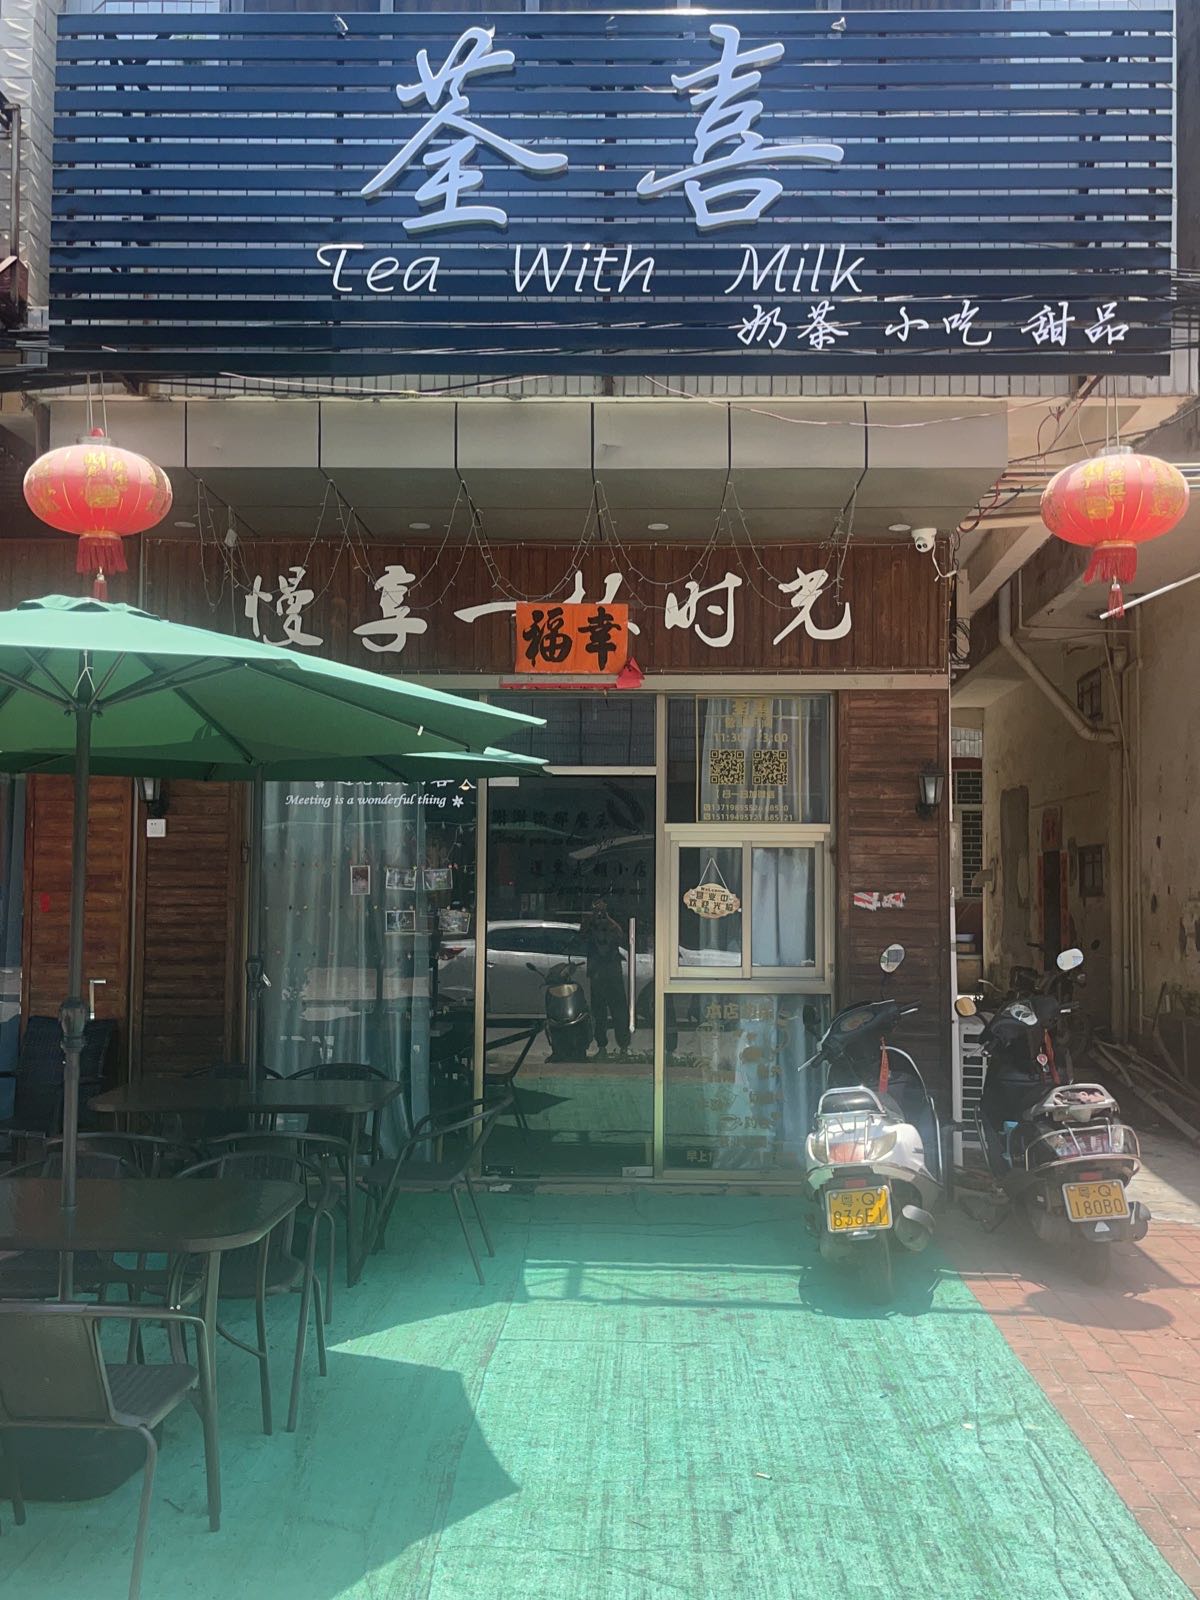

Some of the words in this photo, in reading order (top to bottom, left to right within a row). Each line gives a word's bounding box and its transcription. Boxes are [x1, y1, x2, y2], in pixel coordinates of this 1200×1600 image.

[316, 243, 441, 292] Tea
[515, 243, 655, 293] With
[724, 243, 866, 294] Milk
[736, 300, 849, 350] 奶茶
[885, 300, 992, 347] 小吃
[1020, 301, 1130, 347] 甜品
[285, 794, 332, 808] Meeting
[334, 795, 345, 806] is
[346, 798, 355, 806] a
[357, 793, 415, 808] wonderful
[417, 794, 447, 808] thing
